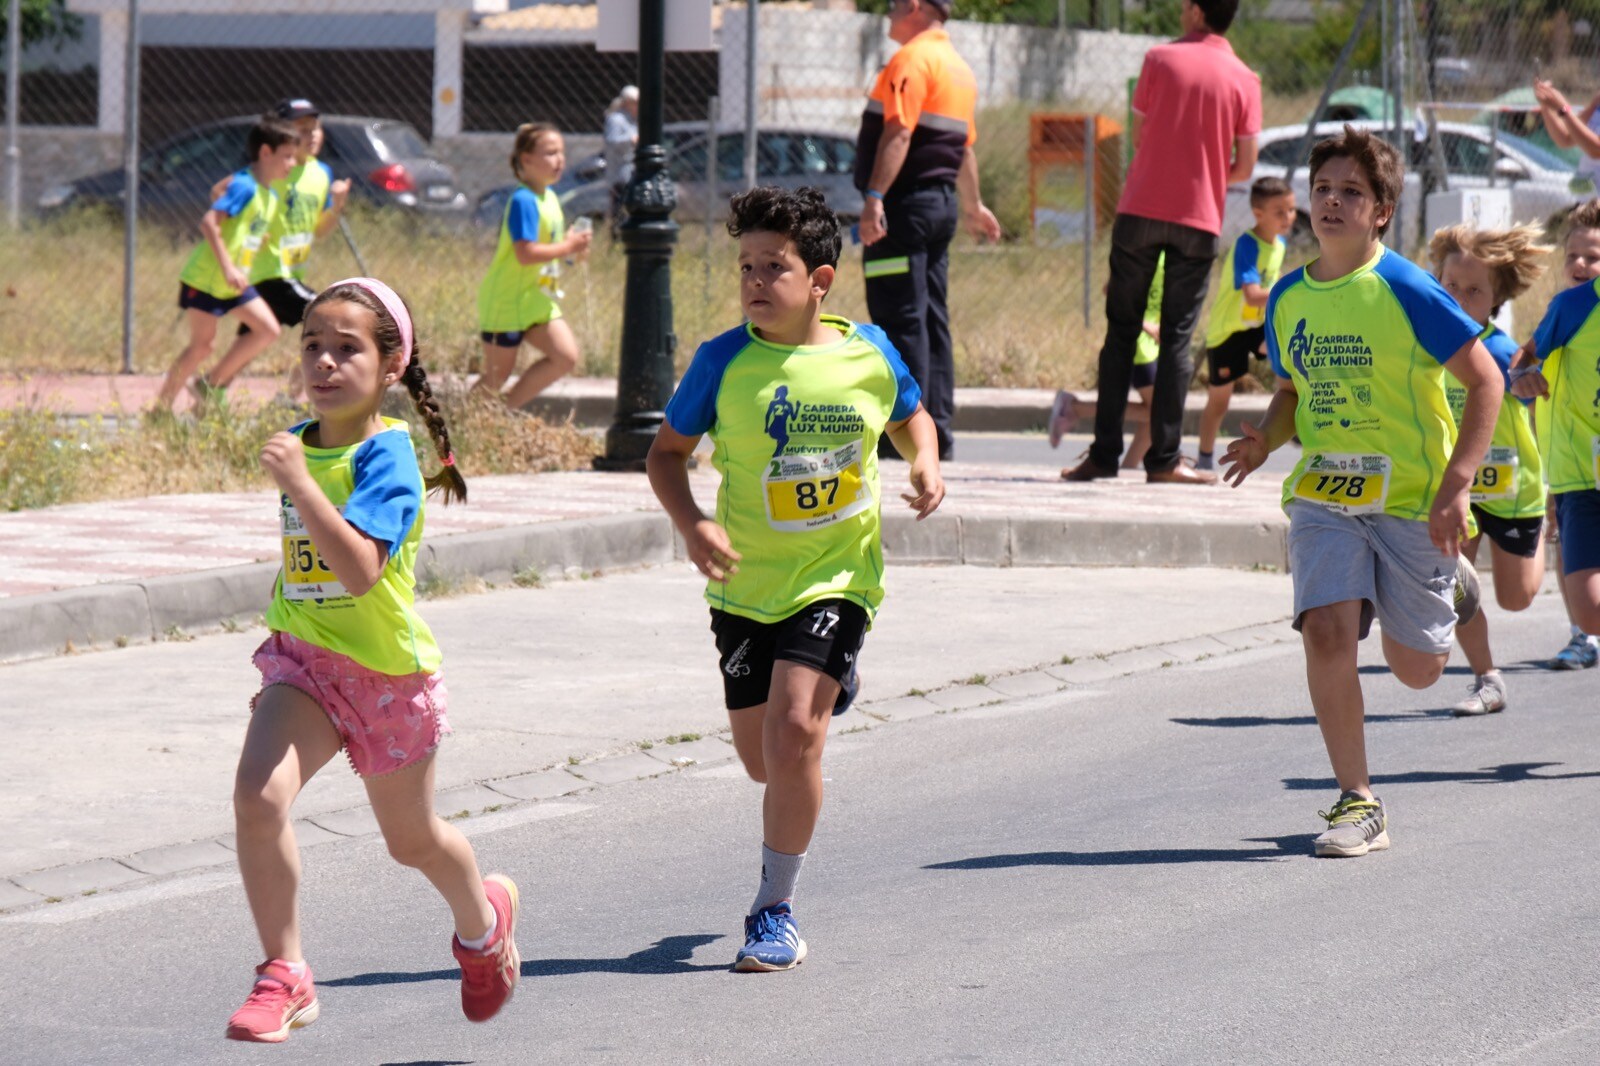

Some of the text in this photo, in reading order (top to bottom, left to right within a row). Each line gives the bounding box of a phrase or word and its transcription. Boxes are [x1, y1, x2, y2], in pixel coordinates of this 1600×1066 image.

[1315, 335, 1364, 344] CARRERA
[1313, 345, 1372, 356] SOLIDARIA
[1304, 356, 1373, 368] LUX MUNDI
[803, 404, 856, 413] CARRERA
[800, 413, 865, 423] SOLIDARIA
[789, 423, 865, 434] LUX MUNDI
[786, 446, 828, 454] MUÉVETE
[1315, 475, 1366, 498] 178
[796, 477, 839, 509] 87
